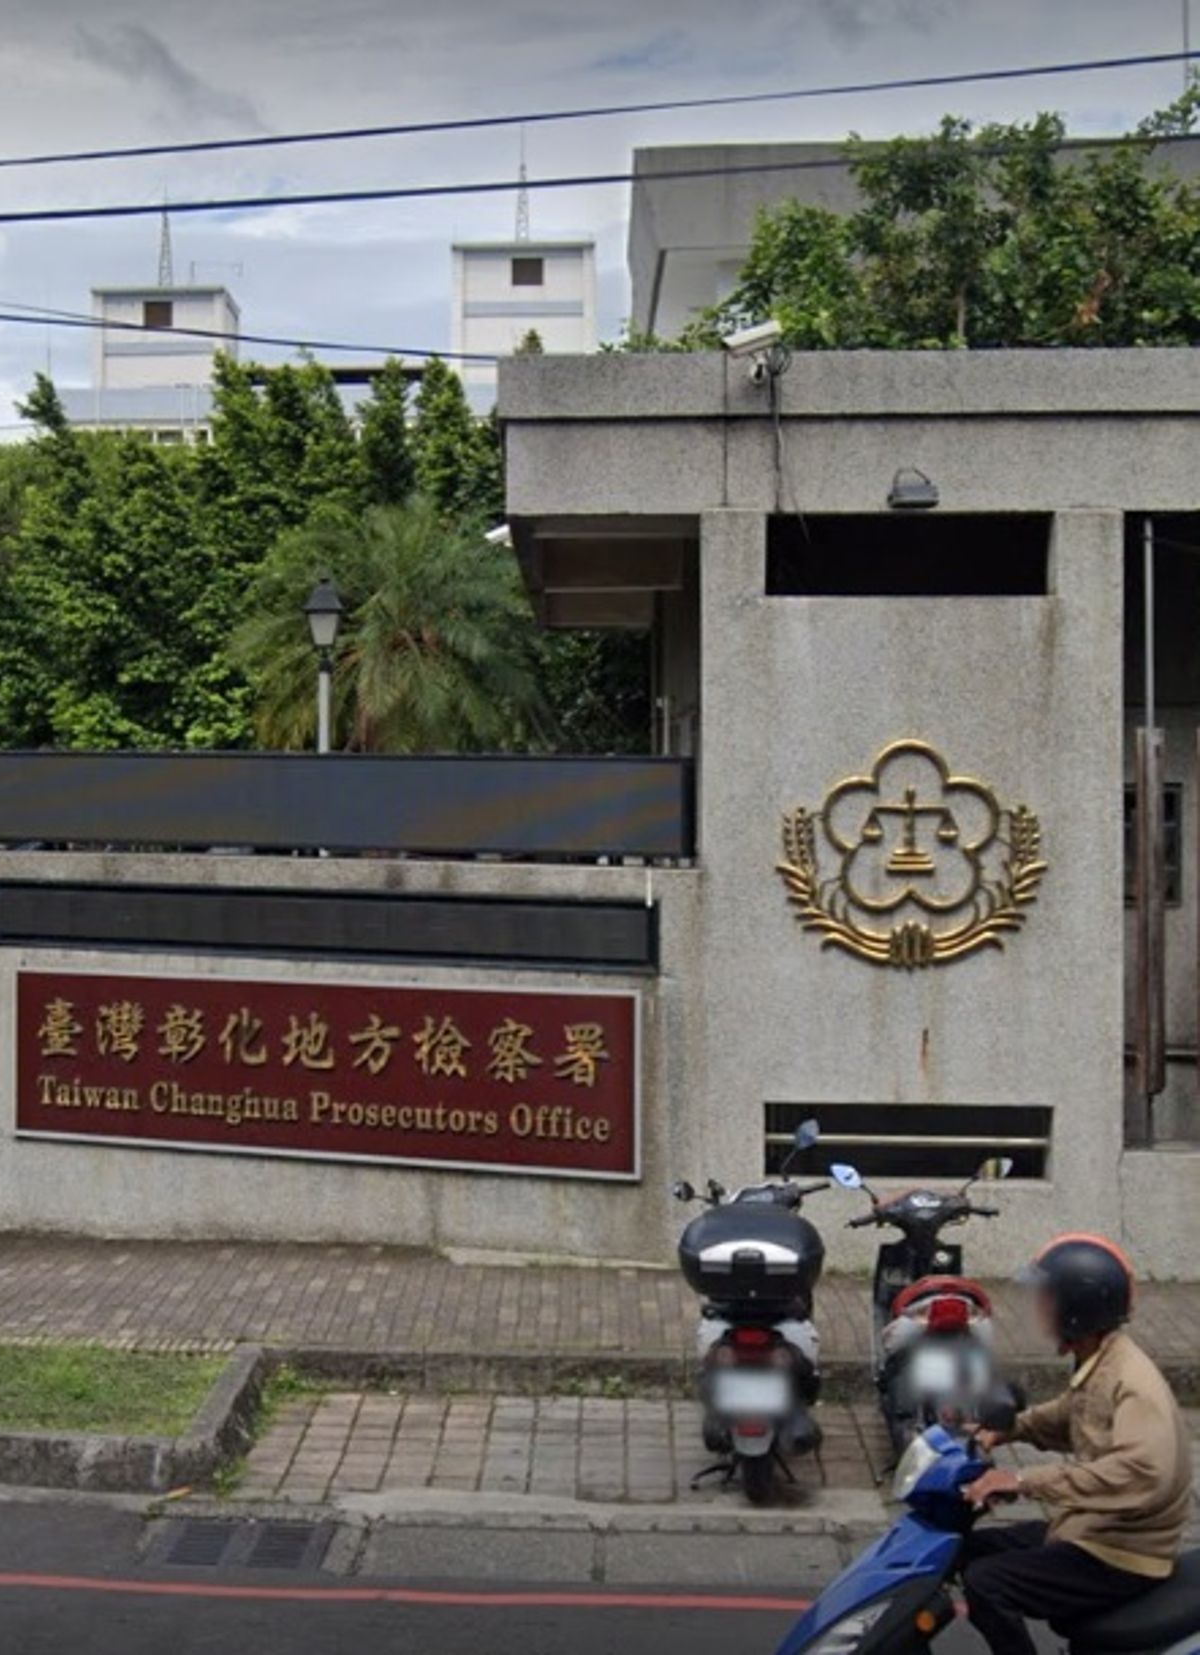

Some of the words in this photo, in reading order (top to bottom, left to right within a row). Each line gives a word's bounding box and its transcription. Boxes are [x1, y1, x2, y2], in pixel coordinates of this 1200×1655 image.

[38, 998, 611, 1087] 臺灣彰化地方檢察署
[39, 1075, 140, 1110] Taiwan
[150, 1082, 298, 1124] Changhua
[308, 1091, 499, 1134] Prosecutors
[509, 1105, 611, 1141] Office
